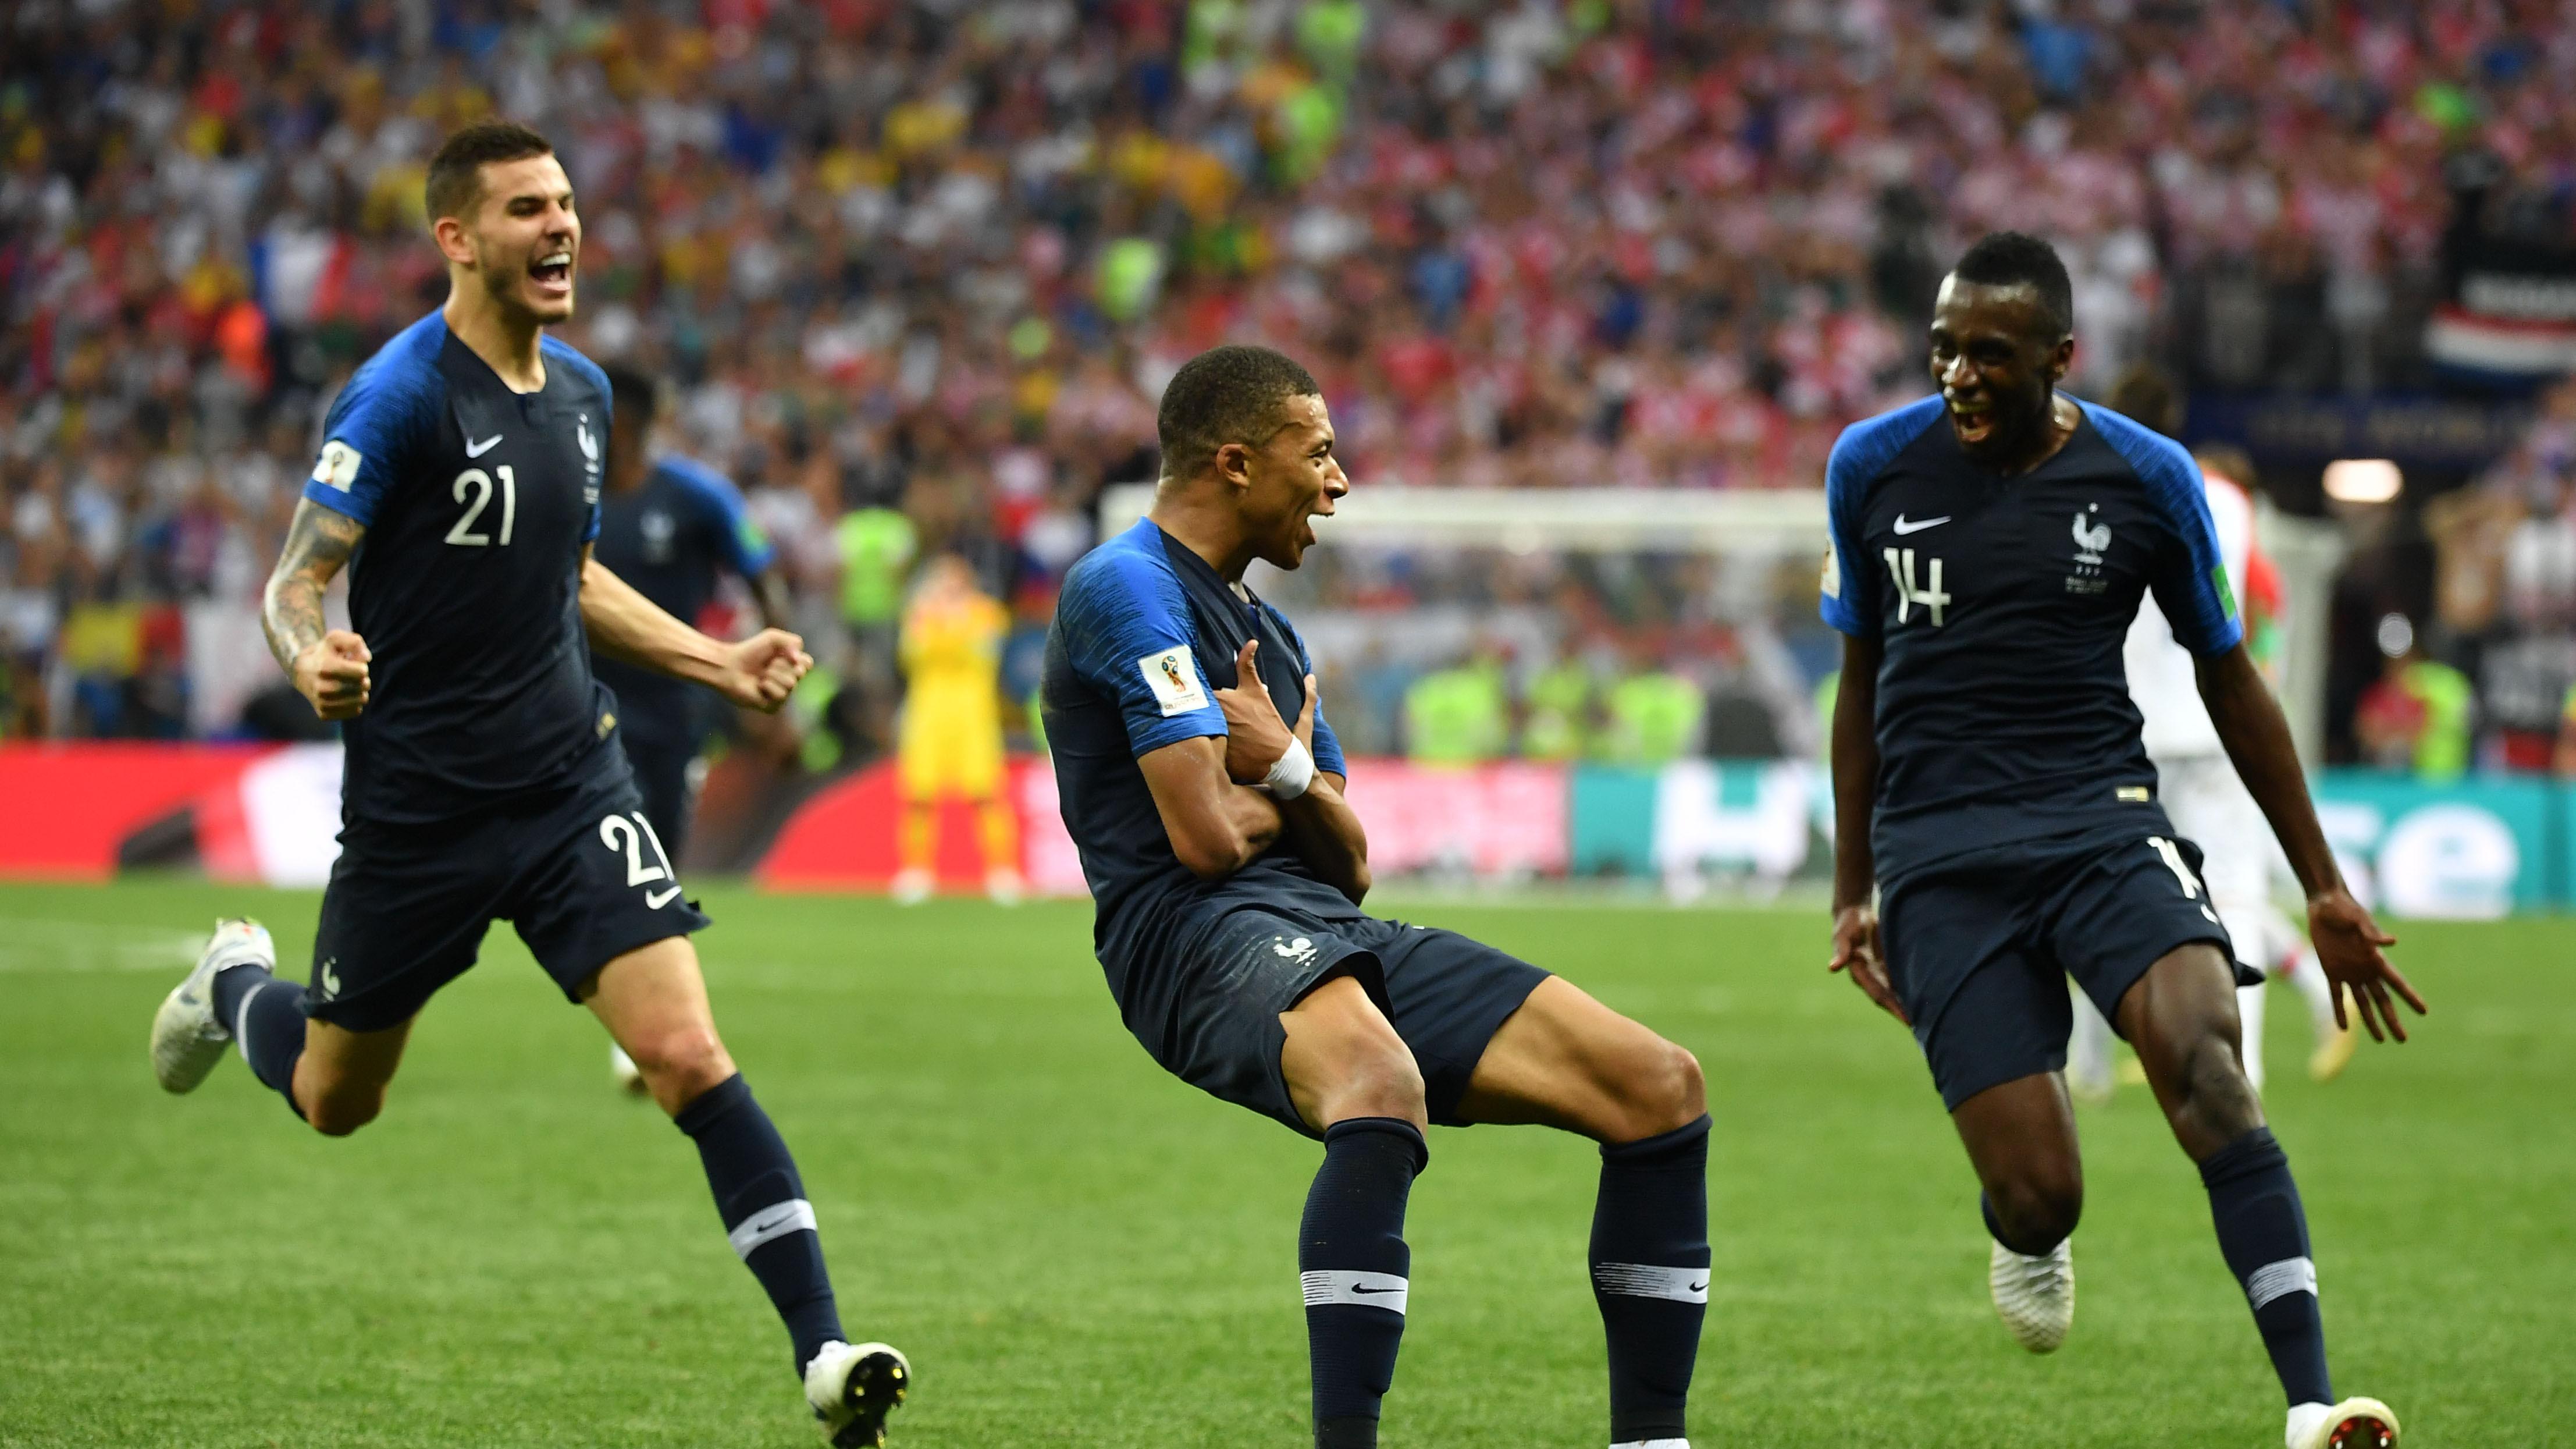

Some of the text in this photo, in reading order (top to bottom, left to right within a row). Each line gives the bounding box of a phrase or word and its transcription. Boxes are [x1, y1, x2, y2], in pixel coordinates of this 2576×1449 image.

[444, 465, 515, 546] 21
[1883, 546, 1951, 627] 14
[599, 811, 675, 887] 21
